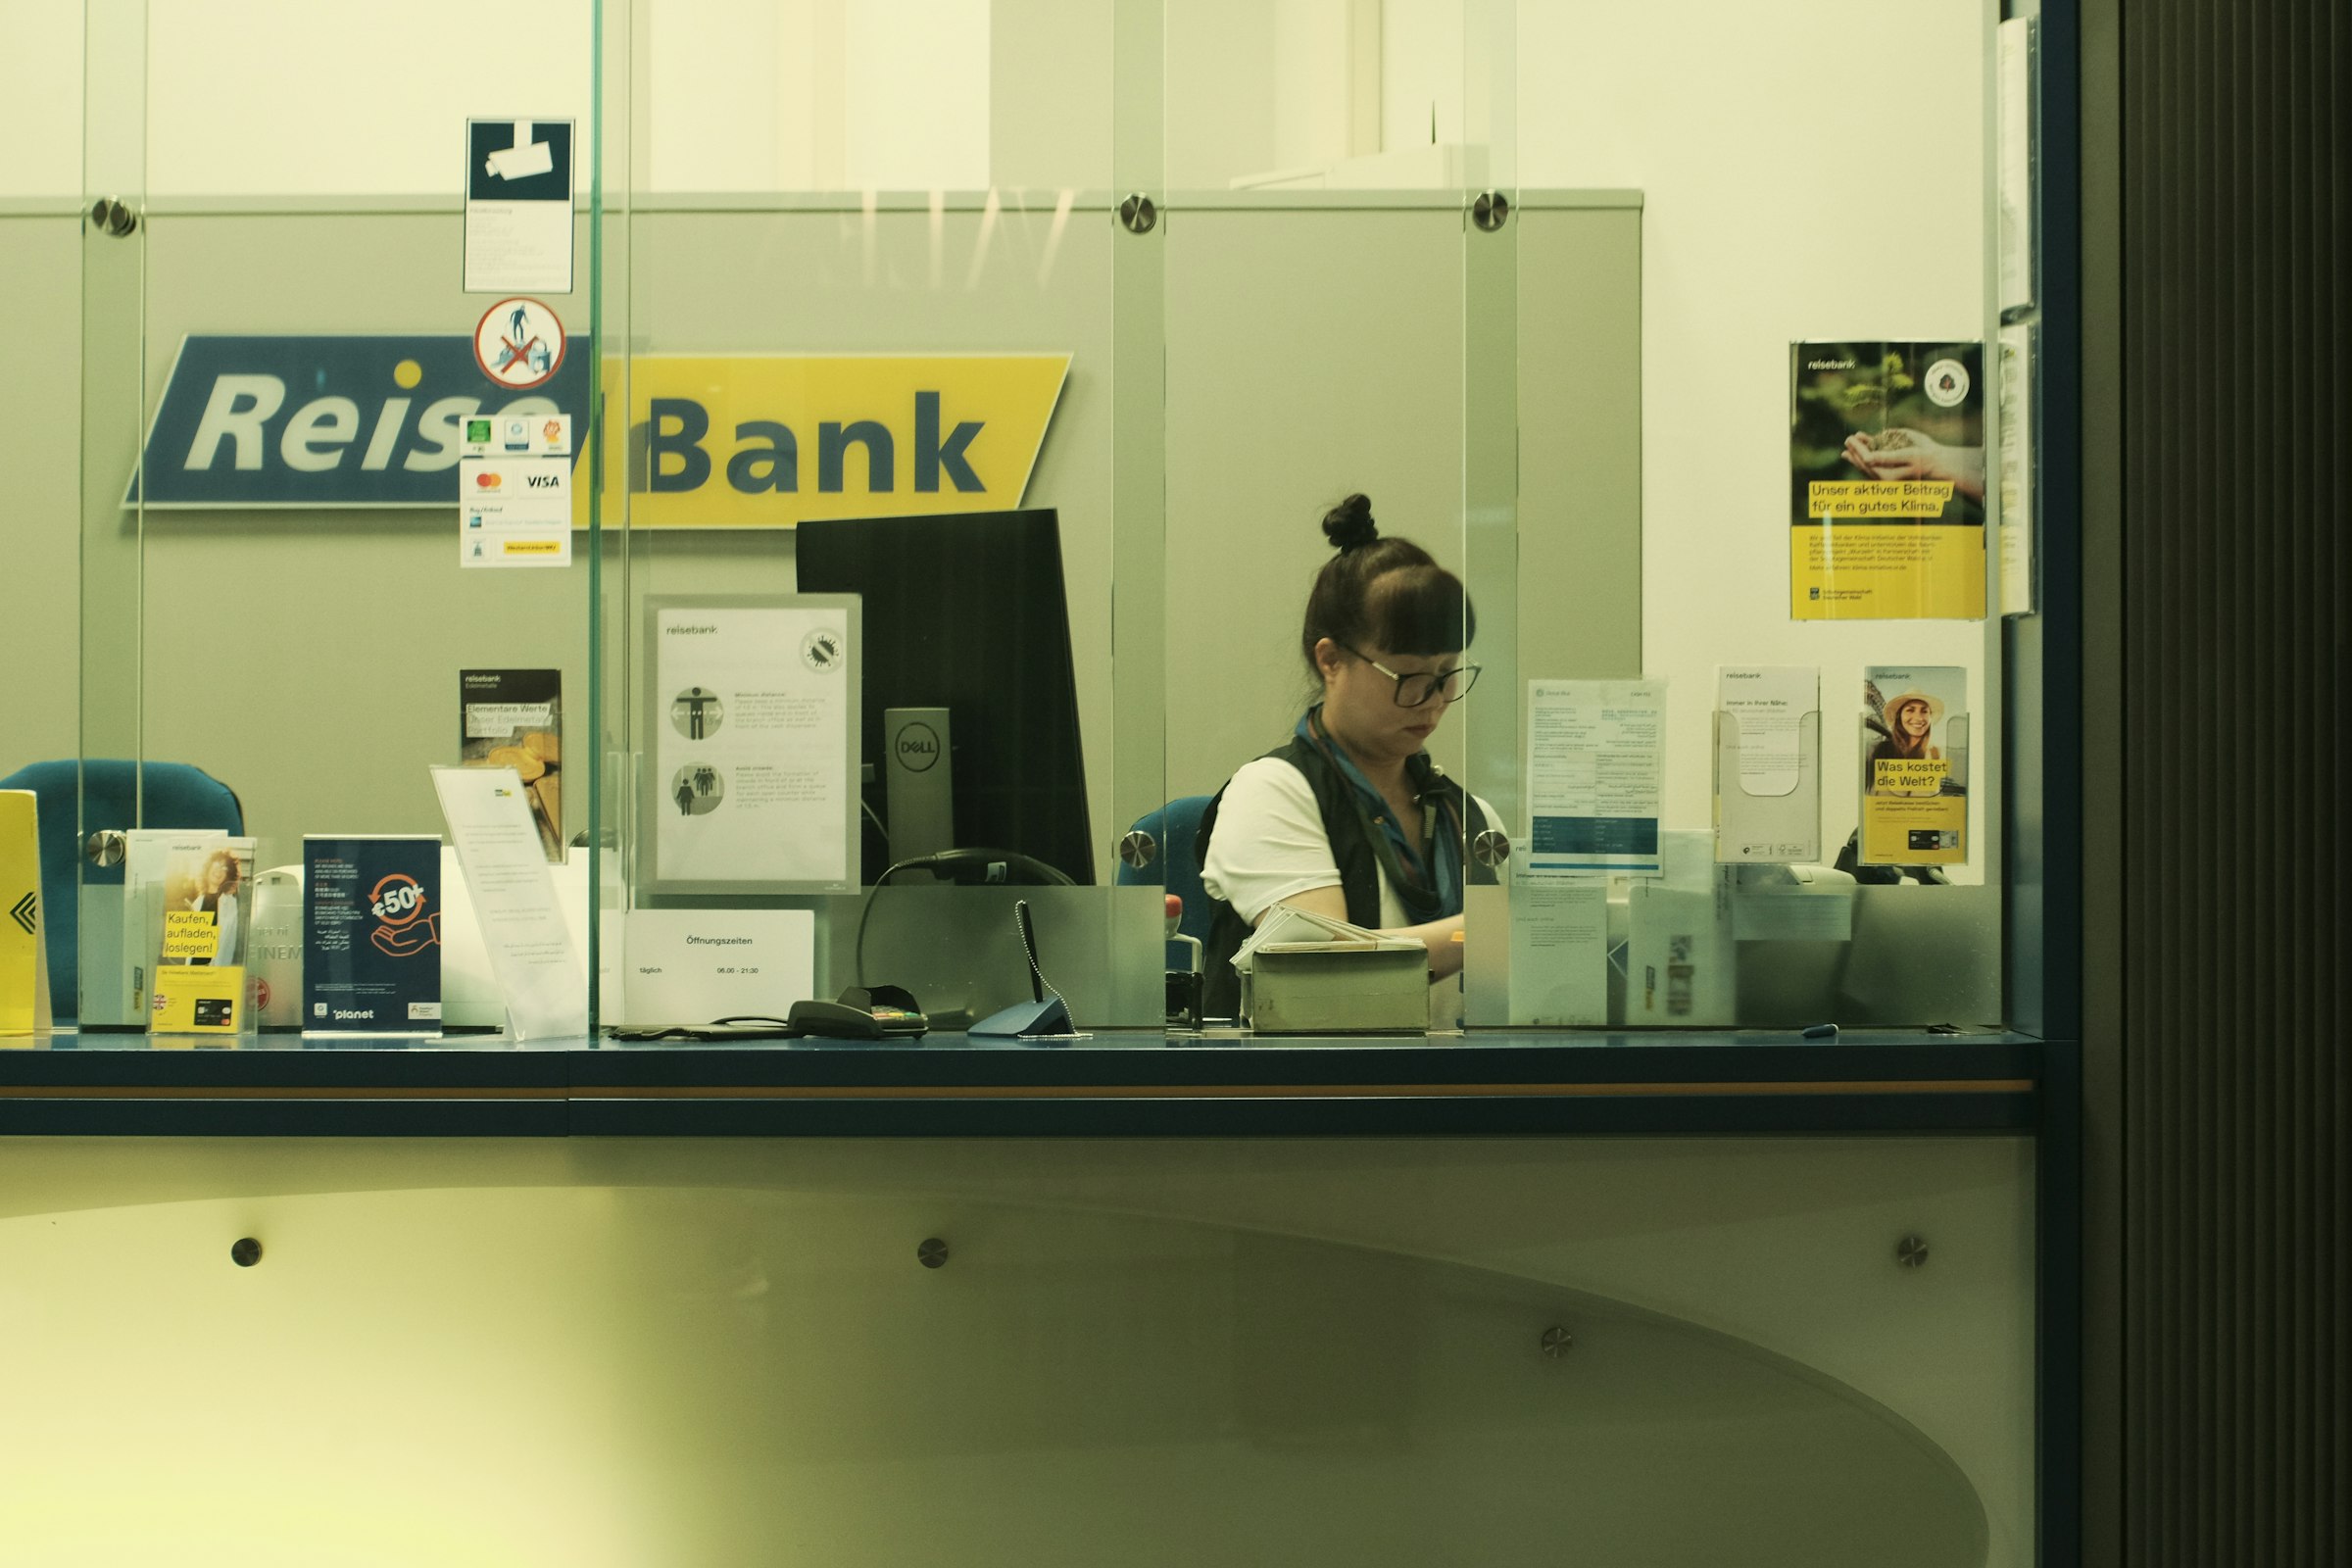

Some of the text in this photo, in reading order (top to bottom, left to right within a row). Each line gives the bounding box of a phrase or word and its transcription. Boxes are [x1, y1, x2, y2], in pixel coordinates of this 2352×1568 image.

[182, 359, 987, 494] Reis Bank
[528, 476, 560, 487] VISA
[1812, 484, 1949, 499] Unser aktiver Beitrag
[1812, 501, 1939, 514] für ein gutes Klima.
[902, 741, 935, 753] DELL
[1877, 761, 1947, 772] Was kostet
[1877, 775, 1935, 786] die Welt?
[370, 884, 424, 916] €50+
[169, 913, 209, 925] Kaufen,
[167, 929, 217, 940] aufladen,
[686, 935, 753, 946] Öffnungszeiten
[166, 943, 213, 955] loslegen!
[335, 1009, 373, 1020] planet
